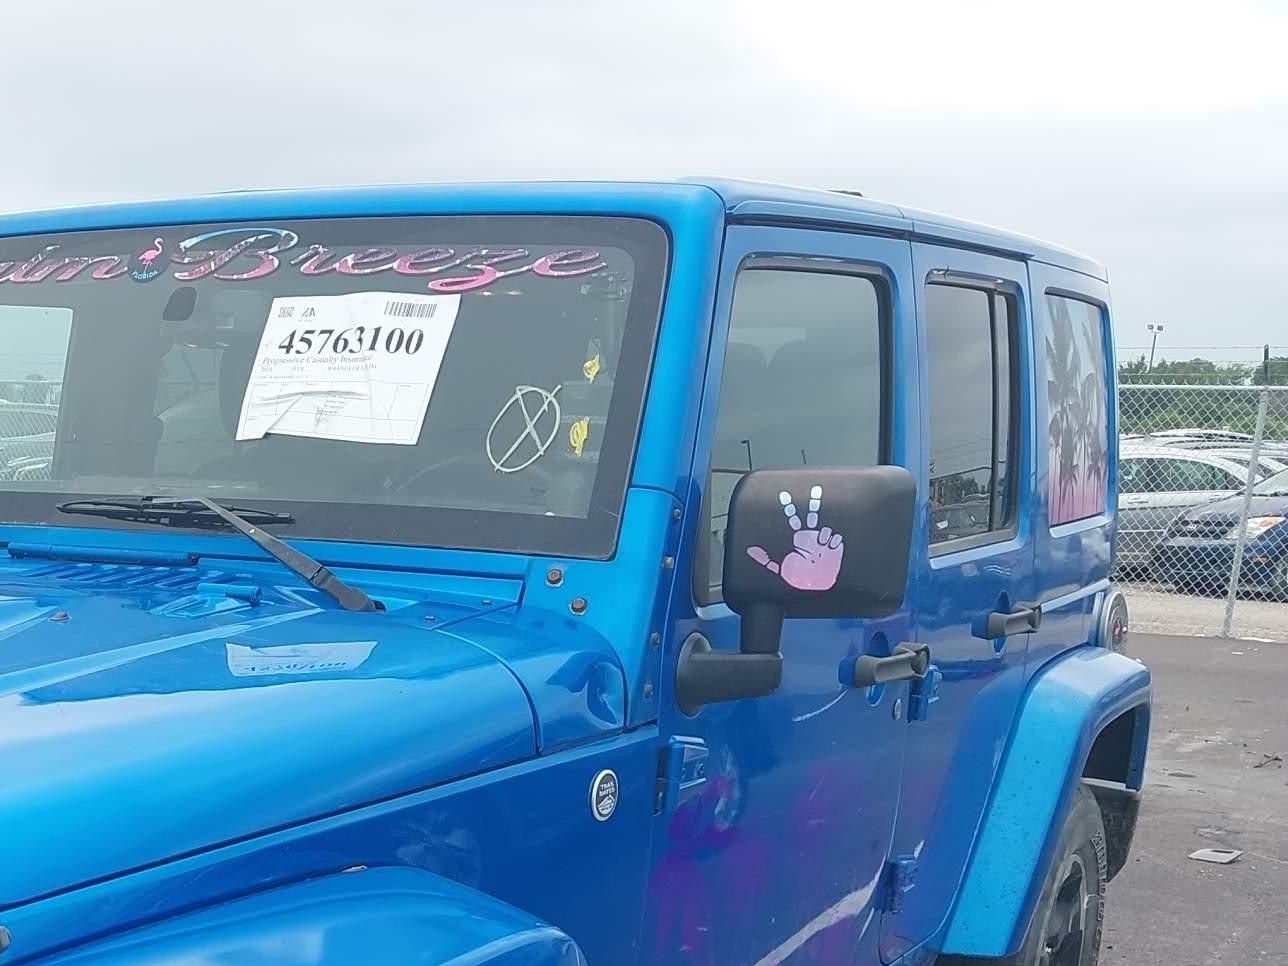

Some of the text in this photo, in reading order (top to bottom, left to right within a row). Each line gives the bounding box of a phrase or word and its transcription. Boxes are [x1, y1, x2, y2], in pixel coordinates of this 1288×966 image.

[171, 227, 609, 292] Breeze
[131, 269, 159, 281] FLORIDA
[277, 325, 425, 356] 45763100
[306, 354, 340, 365] Casualty
